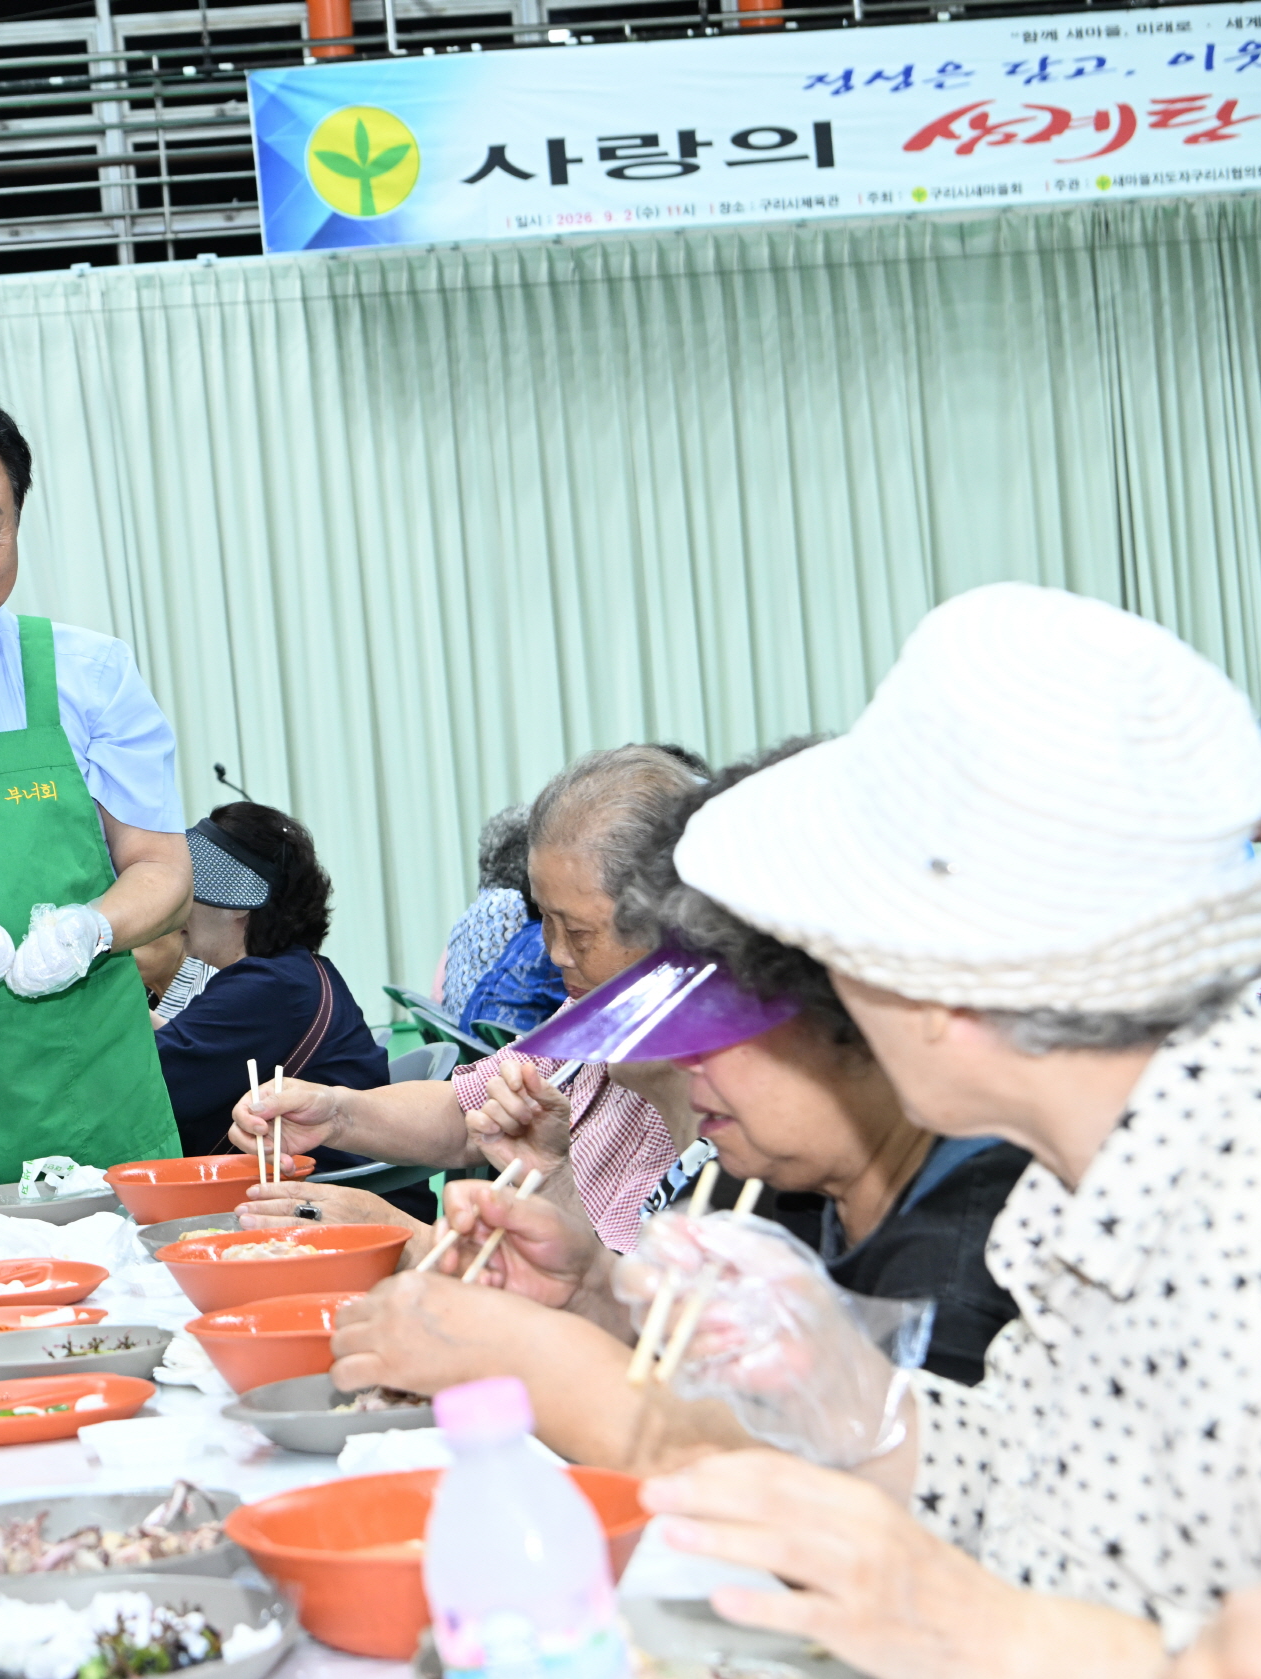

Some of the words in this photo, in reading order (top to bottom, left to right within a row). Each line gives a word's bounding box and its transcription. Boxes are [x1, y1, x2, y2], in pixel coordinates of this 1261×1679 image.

[1137, 21, 1192, 34] 미래로
[802, 60, 975, 96] 정성은
[460, 120, 835, 186] 사랑의
[515, 213, 542, 228] 일시
[719, 201, 745, 215] 장소
[760, 194, 840, 212] 구리시체육관
[931, 181, 1023, 202] 구리시새마을회
[1112, 165, 1261, 187] 새마을지도자구리시협의
[4, 780, 58, 805] 부녀회
